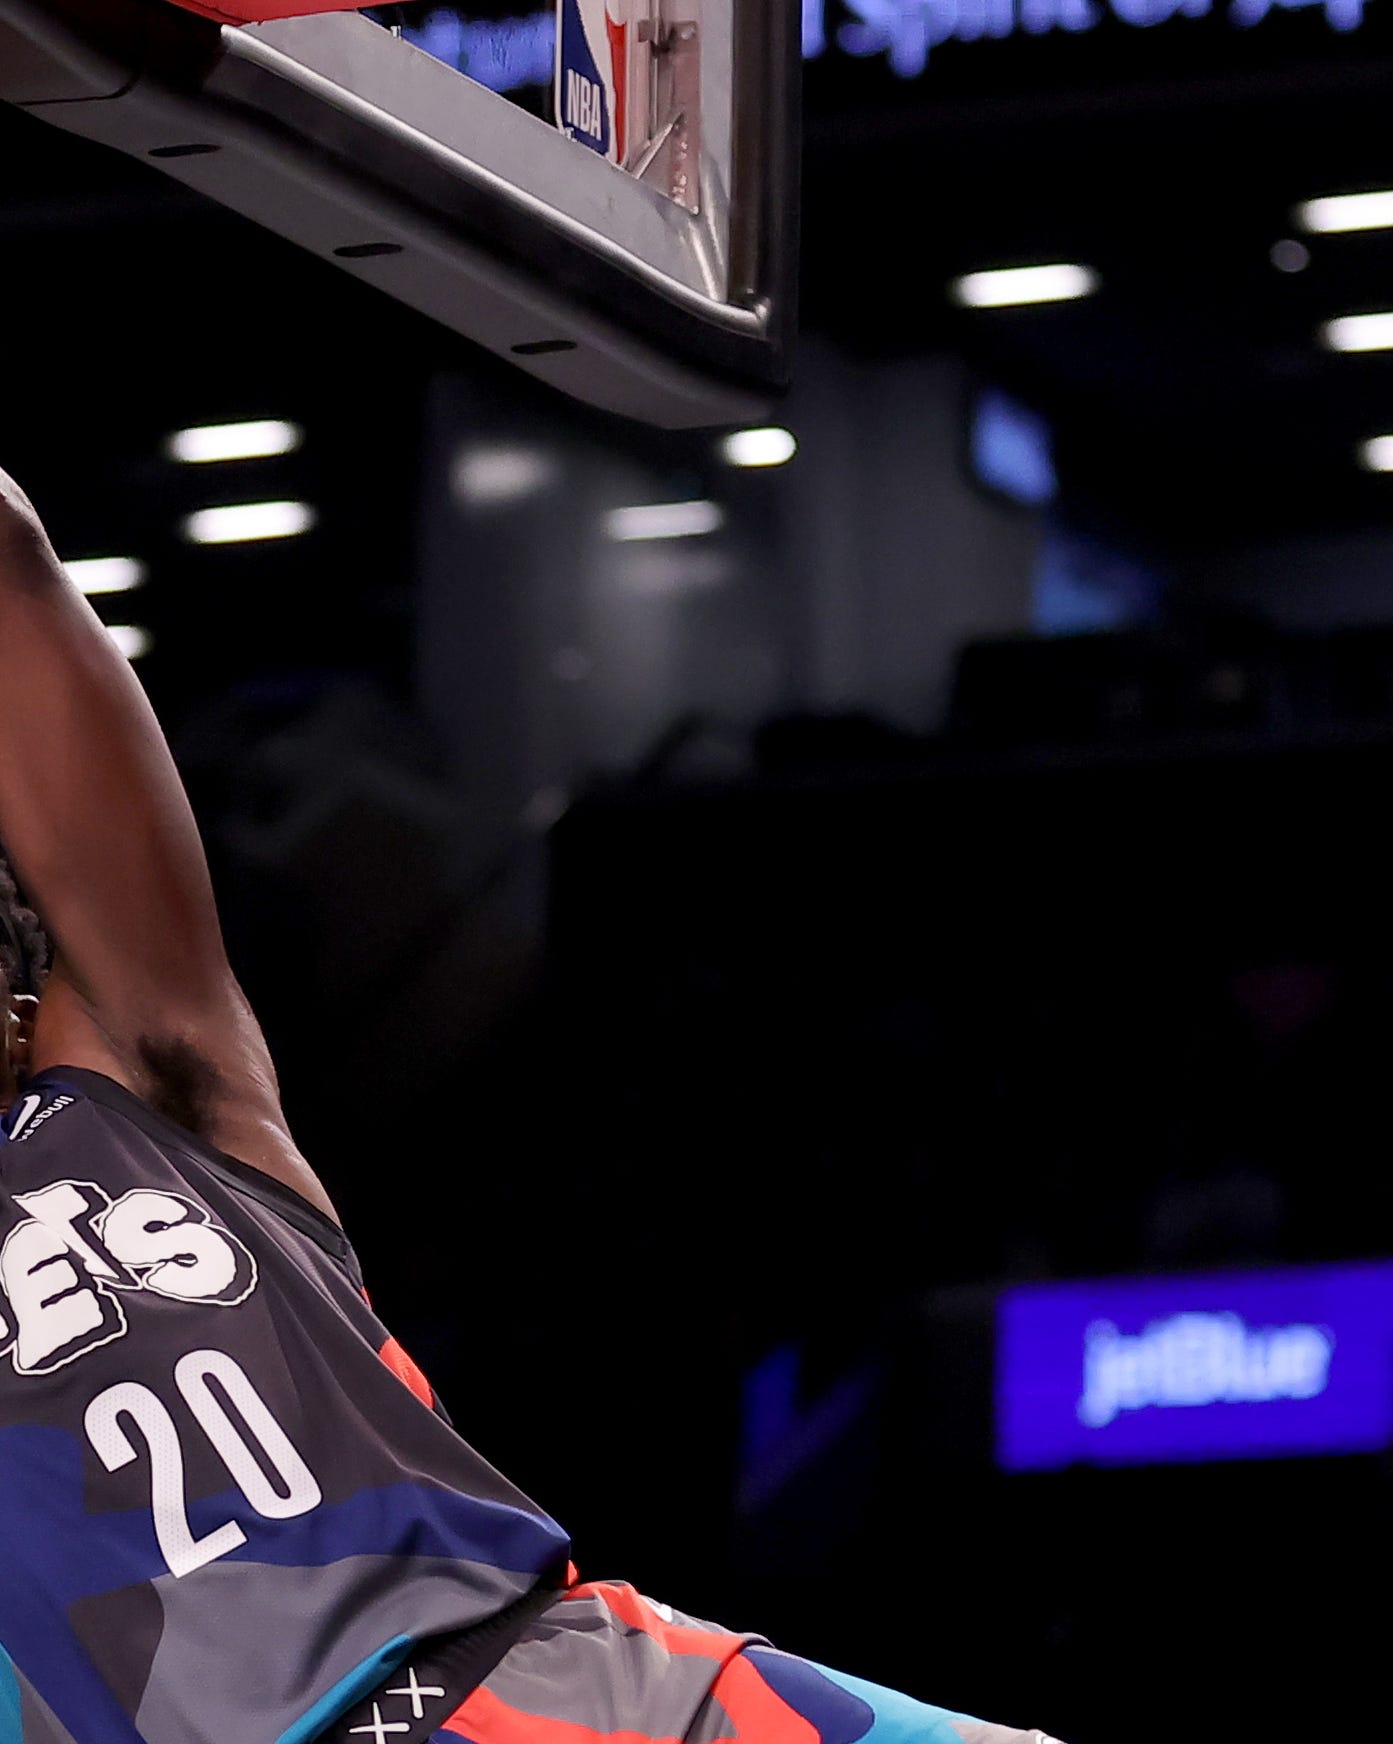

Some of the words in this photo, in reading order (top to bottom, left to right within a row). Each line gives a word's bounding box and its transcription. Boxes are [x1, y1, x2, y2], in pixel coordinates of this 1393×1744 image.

[566, 68, 602, 142] NBA
[1078, 1311, 1333, 1428] jetBlue
[83, 1348, 324, 1580] 20
